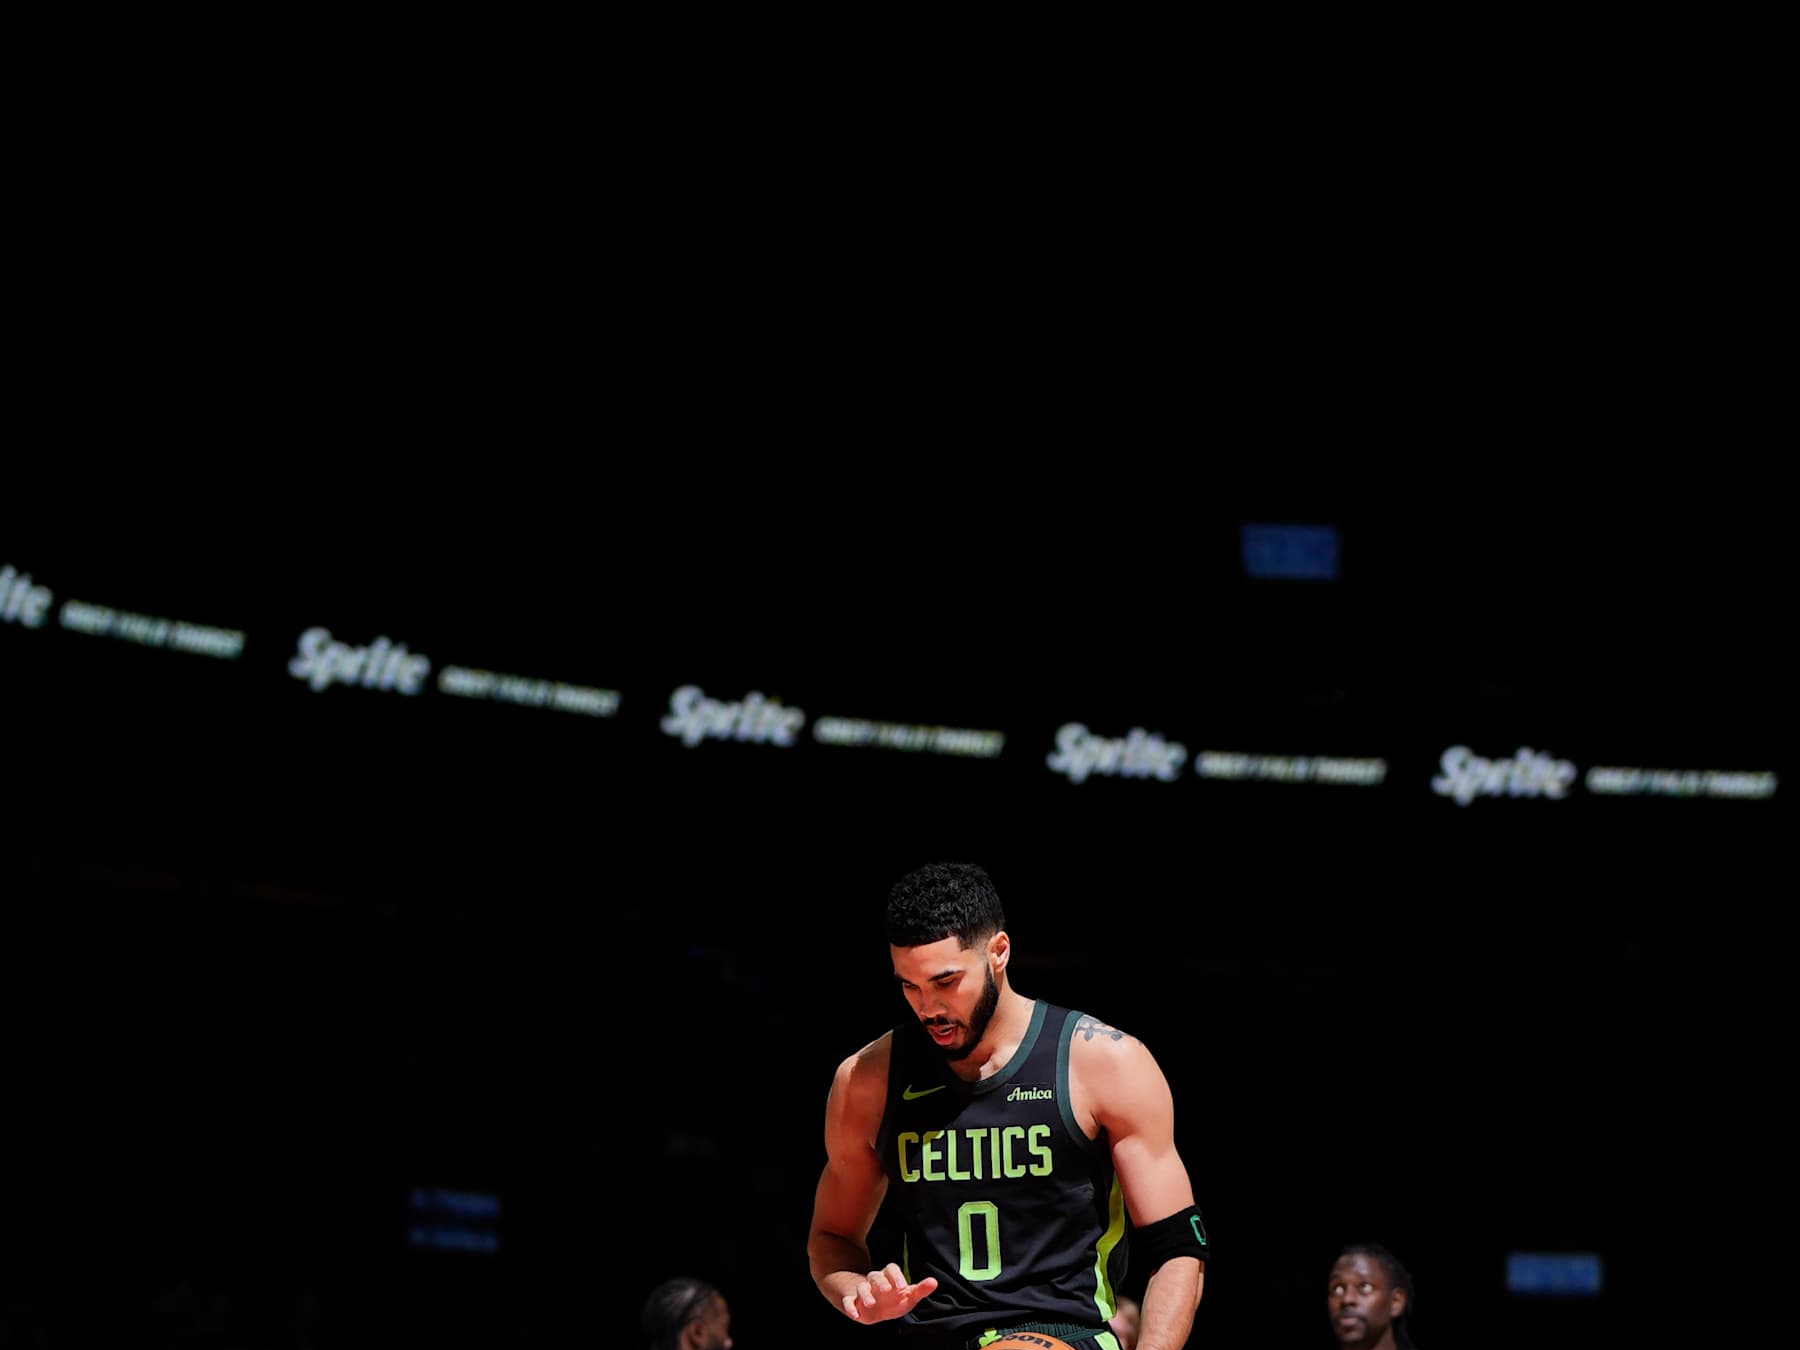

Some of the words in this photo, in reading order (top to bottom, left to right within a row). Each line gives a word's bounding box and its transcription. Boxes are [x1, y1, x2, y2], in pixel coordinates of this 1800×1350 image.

[289, 628, 430, 694] Sprite
[662, 686, 804, 746] Sprite
[1047, 723, 1187, 783] Sprite
[1432, 746, 1576, 805] Sprite
[1007, 1086, 1053, 1102] Amica
[897, 1124, 1053, 1182] CELTICS
[958, 1200, 1002, 1281] 0
